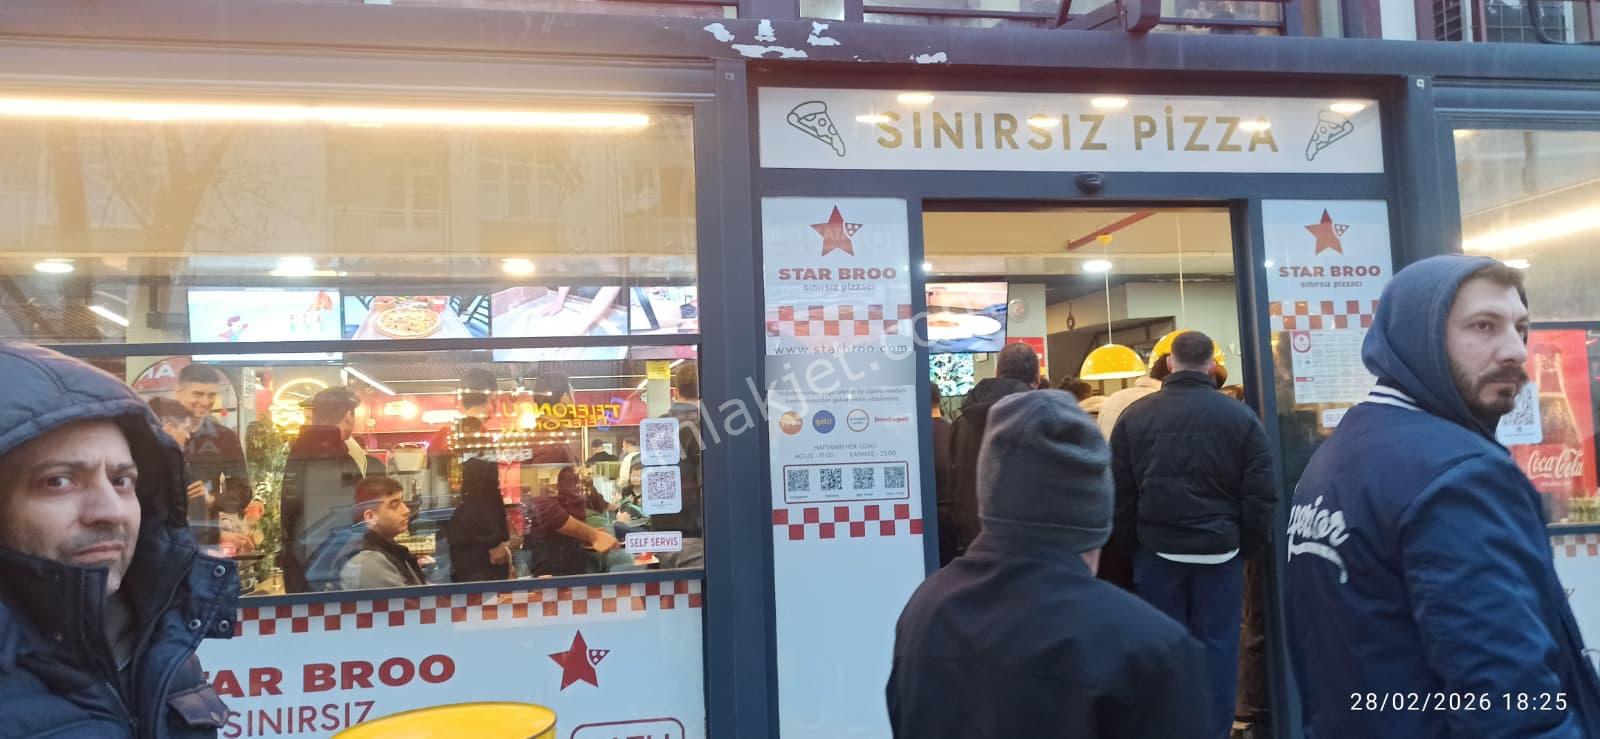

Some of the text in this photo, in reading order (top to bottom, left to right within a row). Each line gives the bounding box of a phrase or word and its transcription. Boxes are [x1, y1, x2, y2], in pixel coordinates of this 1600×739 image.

[876, 105, 1279, 153] SINIRSIZ PİZZA
[778, 267, 897, 281] STAR BROO
[1279, 265, 1381, 278] STAR BROO
[629, 537, 648, 548] SELF
[203, 654, 456, 698] AR BROO
[223, 700, 376, 739] SINIRSIZ
